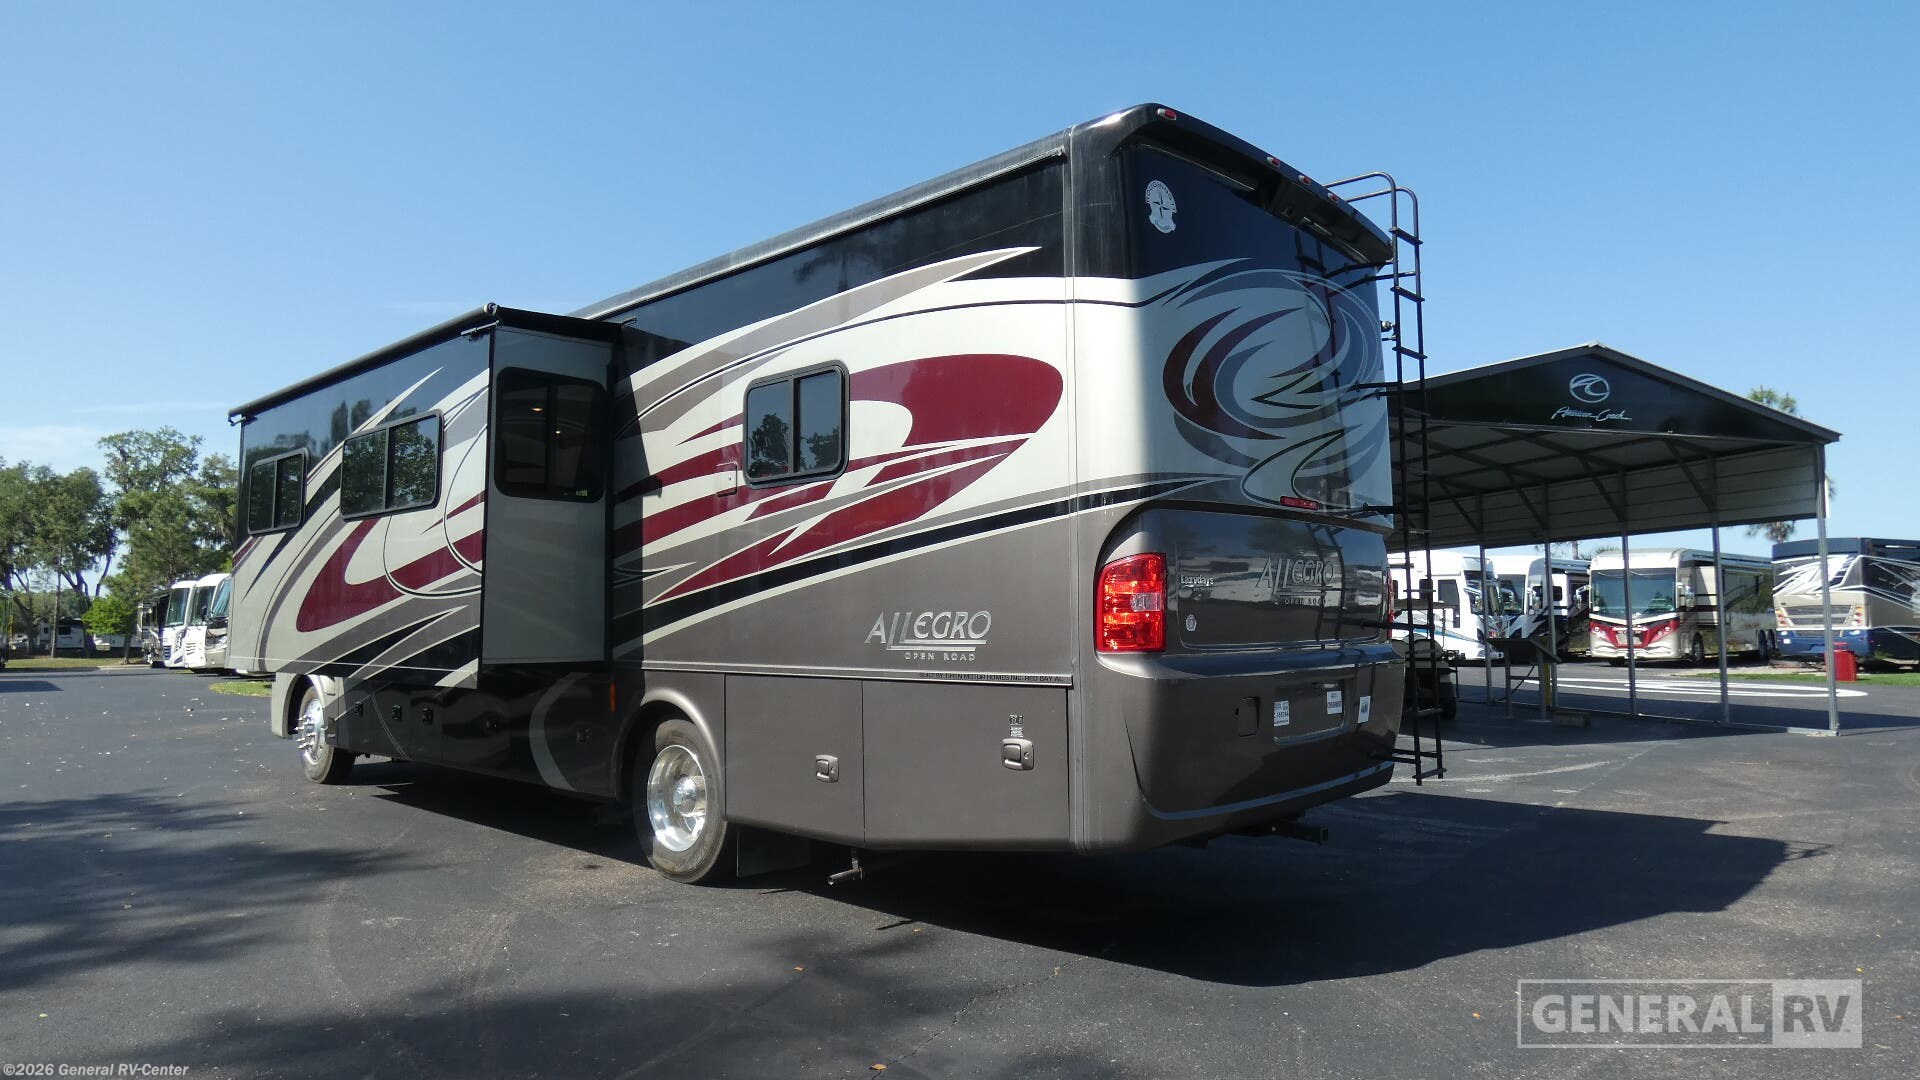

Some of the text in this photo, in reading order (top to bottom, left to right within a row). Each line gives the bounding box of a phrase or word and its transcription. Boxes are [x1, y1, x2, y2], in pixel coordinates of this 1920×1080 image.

[864, 610, 992, 650] ALLEGRO
[904, 652, 976, 661] OPEN ROAD
